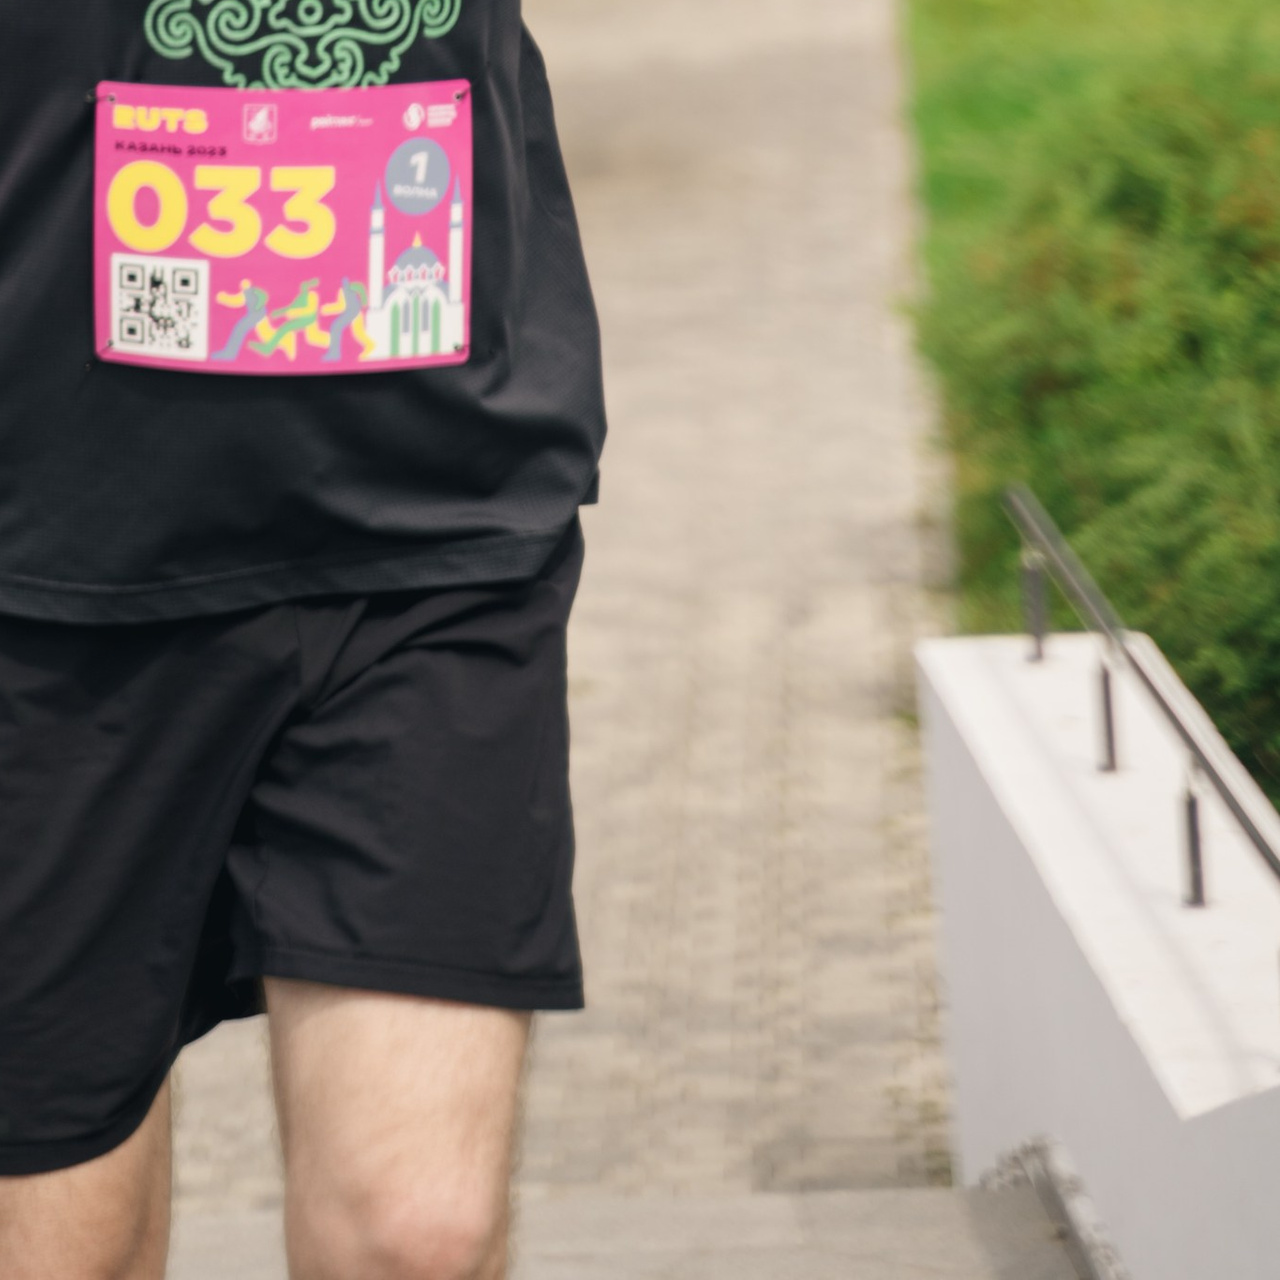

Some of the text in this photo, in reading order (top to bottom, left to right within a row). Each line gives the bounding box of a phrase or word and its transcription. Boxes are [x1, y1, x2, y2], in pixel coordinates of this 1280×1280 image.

[113, 103, 208, 135] RUTS
[115, 141, 227, 157] КАЗАНЬ 2023
[410, 151, 429, 184] 1
[393, 184, 438, 199] ВОЛНА
[106, 160, 336, 258] 033
